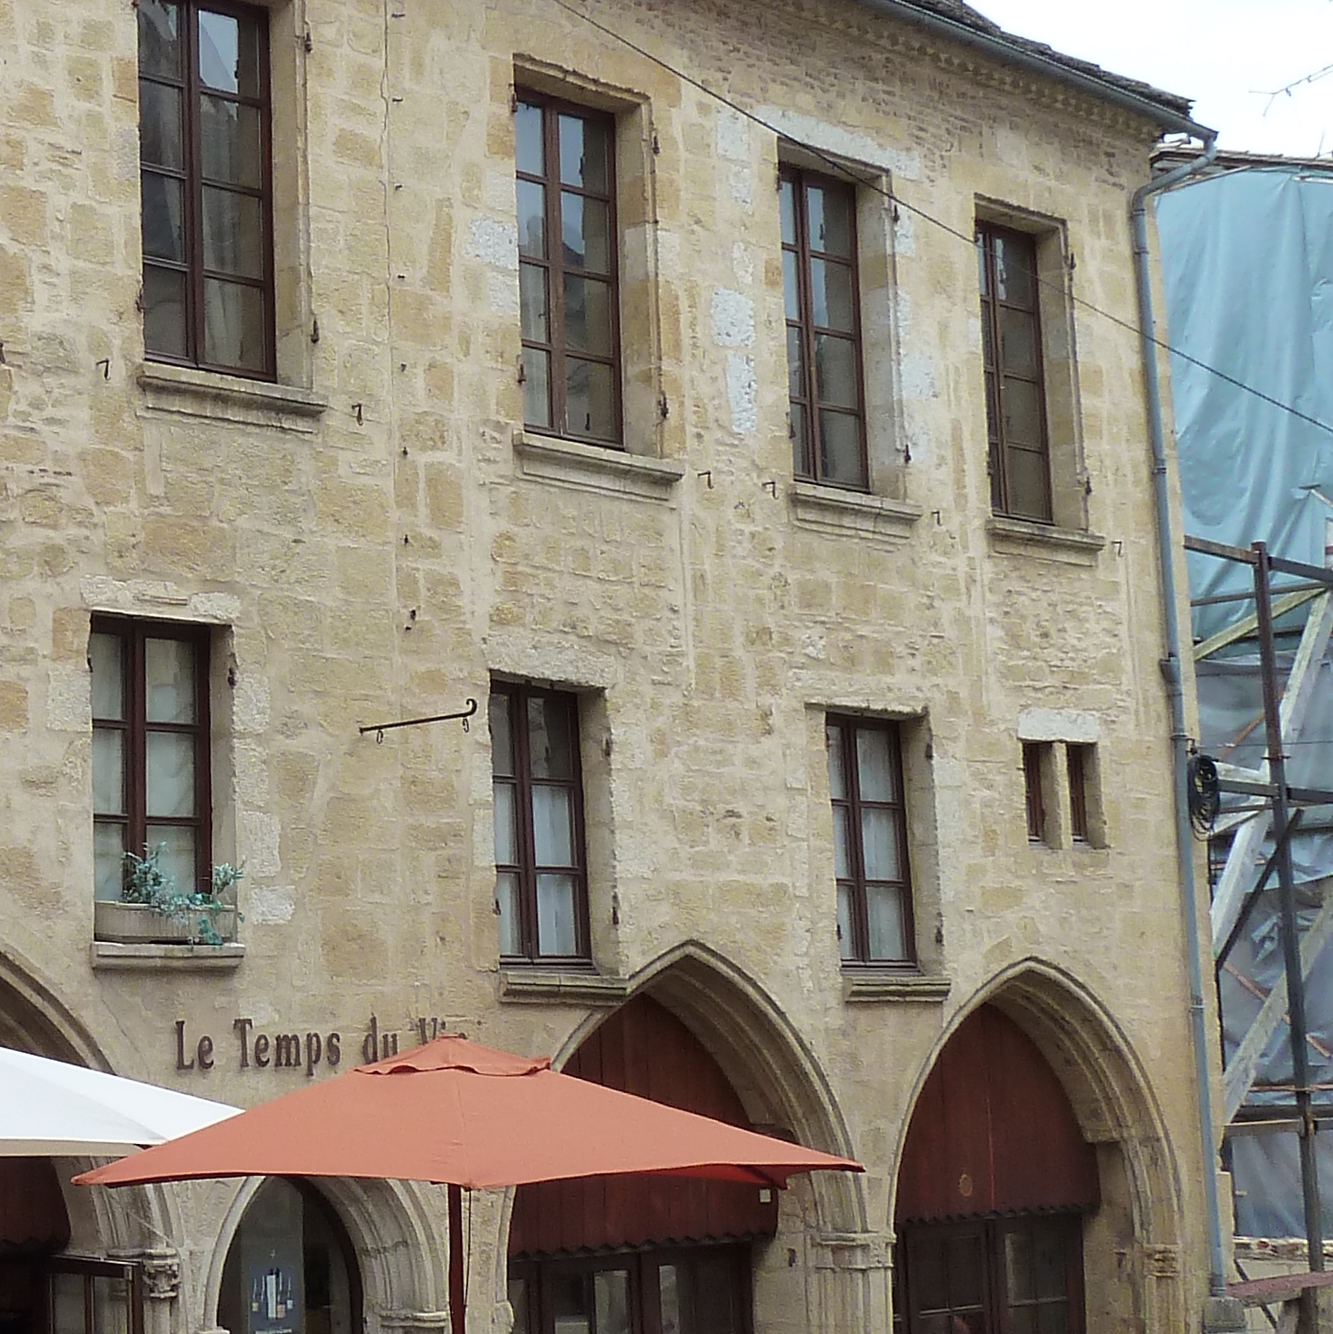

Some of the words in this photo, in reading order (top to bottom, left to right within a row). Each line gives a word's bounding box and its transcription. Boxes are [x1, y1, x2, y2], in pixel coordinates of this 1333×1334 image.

[175, 1019, 214, 1070] Le
[233, 1017, 341, 1076] Temps
[362, 1016, 399, 1064] du
